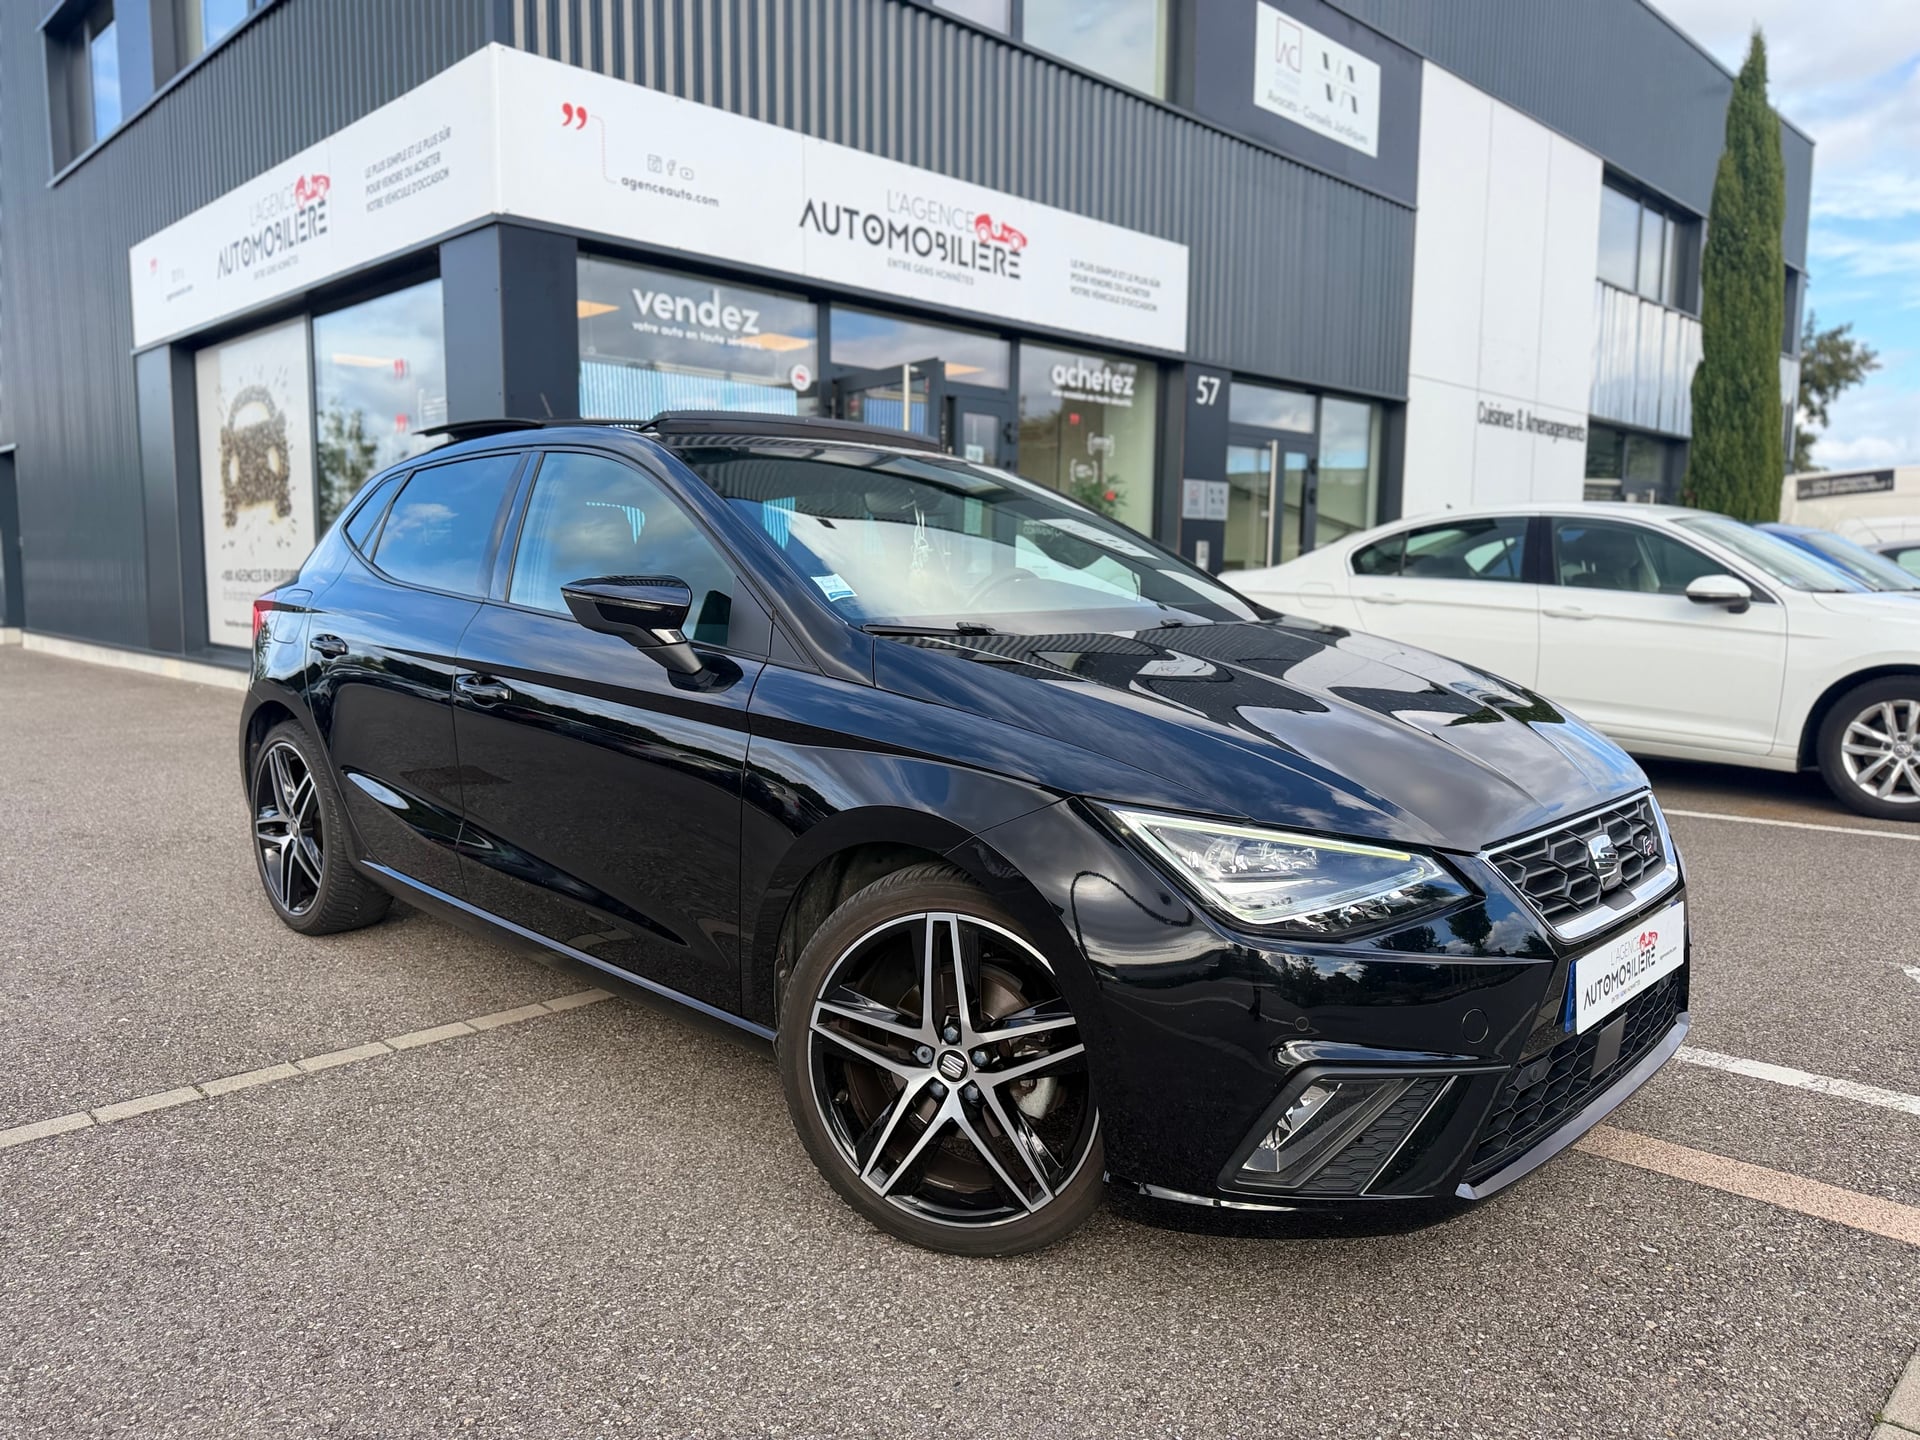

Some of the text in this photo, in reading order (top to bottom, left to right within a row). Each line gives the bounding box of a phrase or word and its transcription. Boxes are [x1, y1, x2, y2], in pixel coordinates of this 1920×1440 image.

[621, 177, 720, 206] agenceauto.com
[886, 189, 976, 234] L'AGENCE
[631, 287, 760, 335] vendez
[632, 321, 658, 334] votre
[660, 326, 684, 339] auto
[685, 330, 698, 340] en
[699, 330, 725, 345] toute
[1051, 356, 1135, 397] achetez
[1195, 374, 1222, 407] 57
[1516, 408, 1523, 432] &
